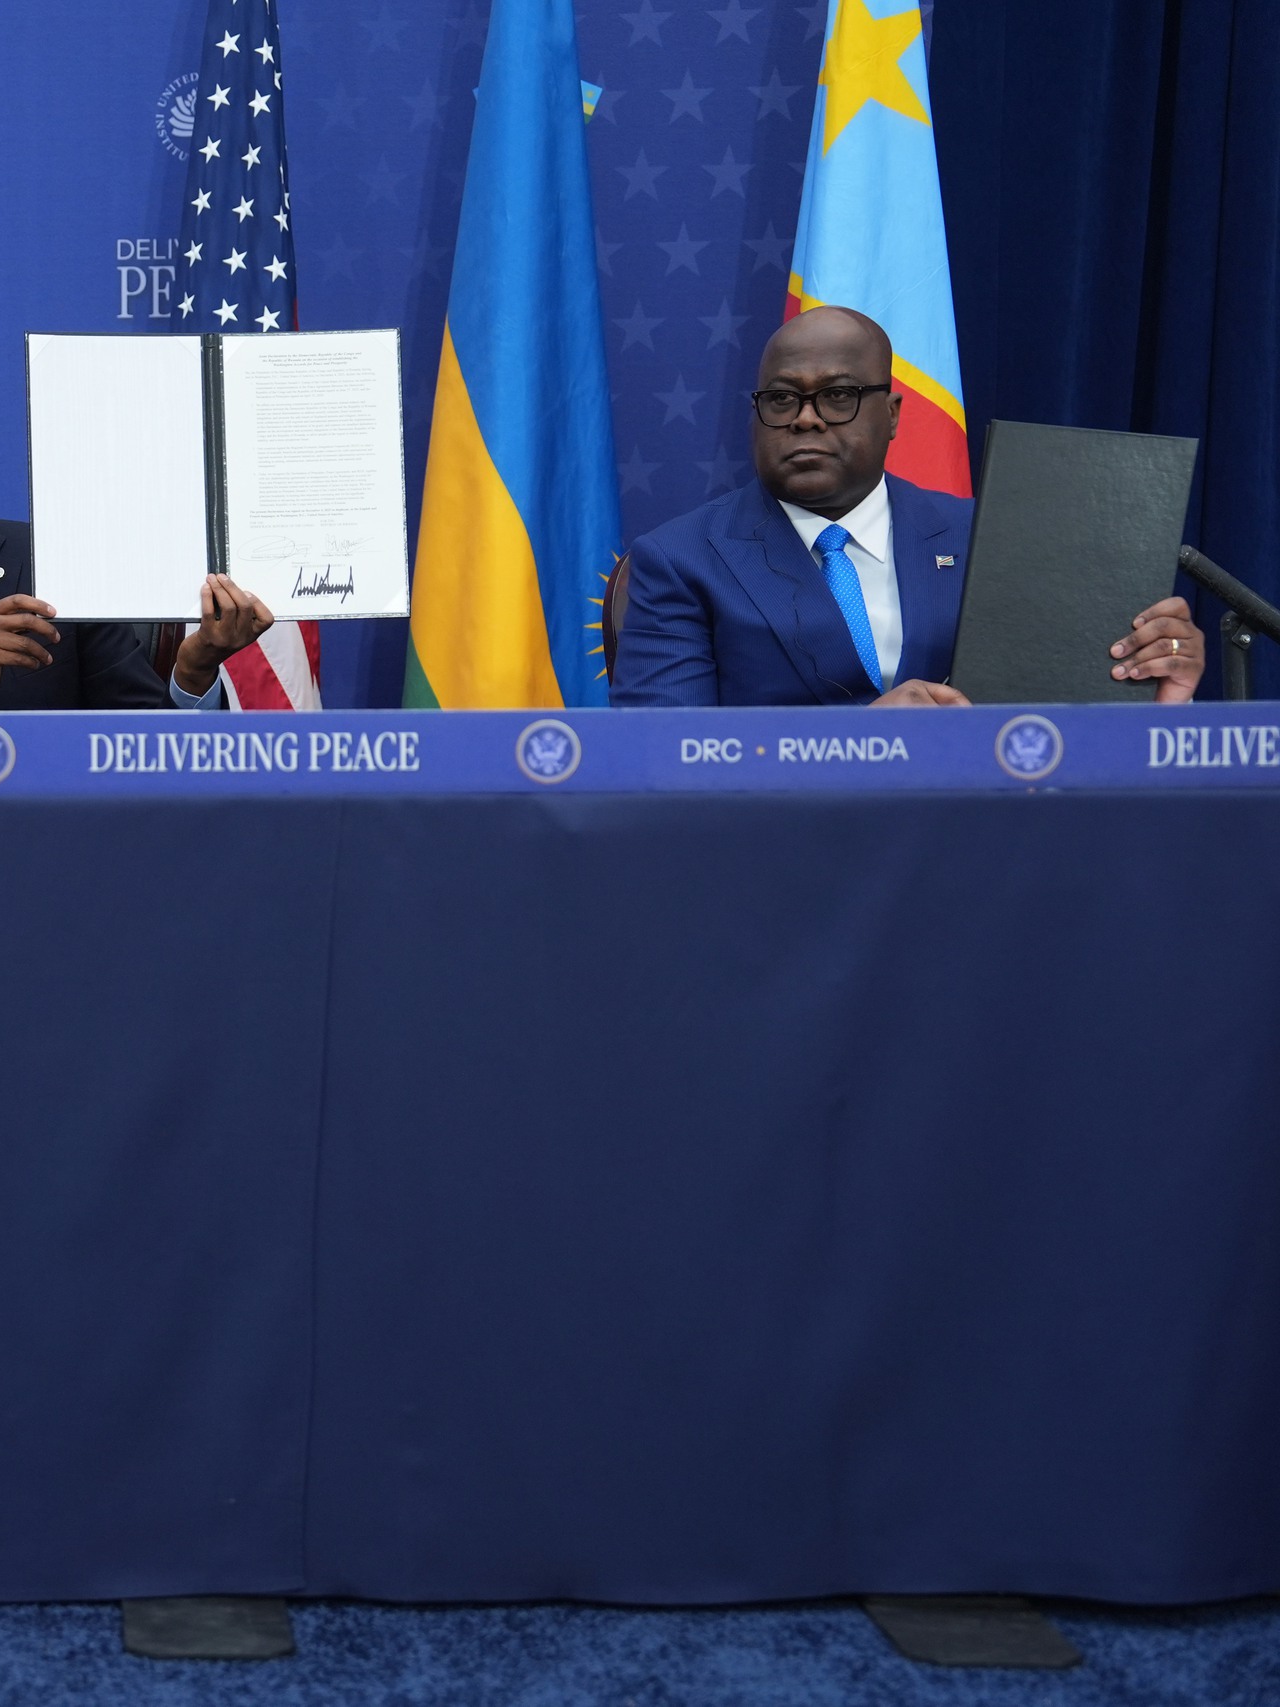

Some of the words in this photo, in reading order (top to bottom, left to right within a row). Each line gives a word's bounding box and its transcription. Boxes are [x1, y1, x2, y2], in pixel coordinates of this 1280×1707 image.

[157, 72, 199, 108] UNITED
[88, 732, 299, 773] DELIVERING
[308, 731, 420, 772] PEACE
[680, 738, 743, 763] DRC
[777, 737, 909, 762] RWANDA
